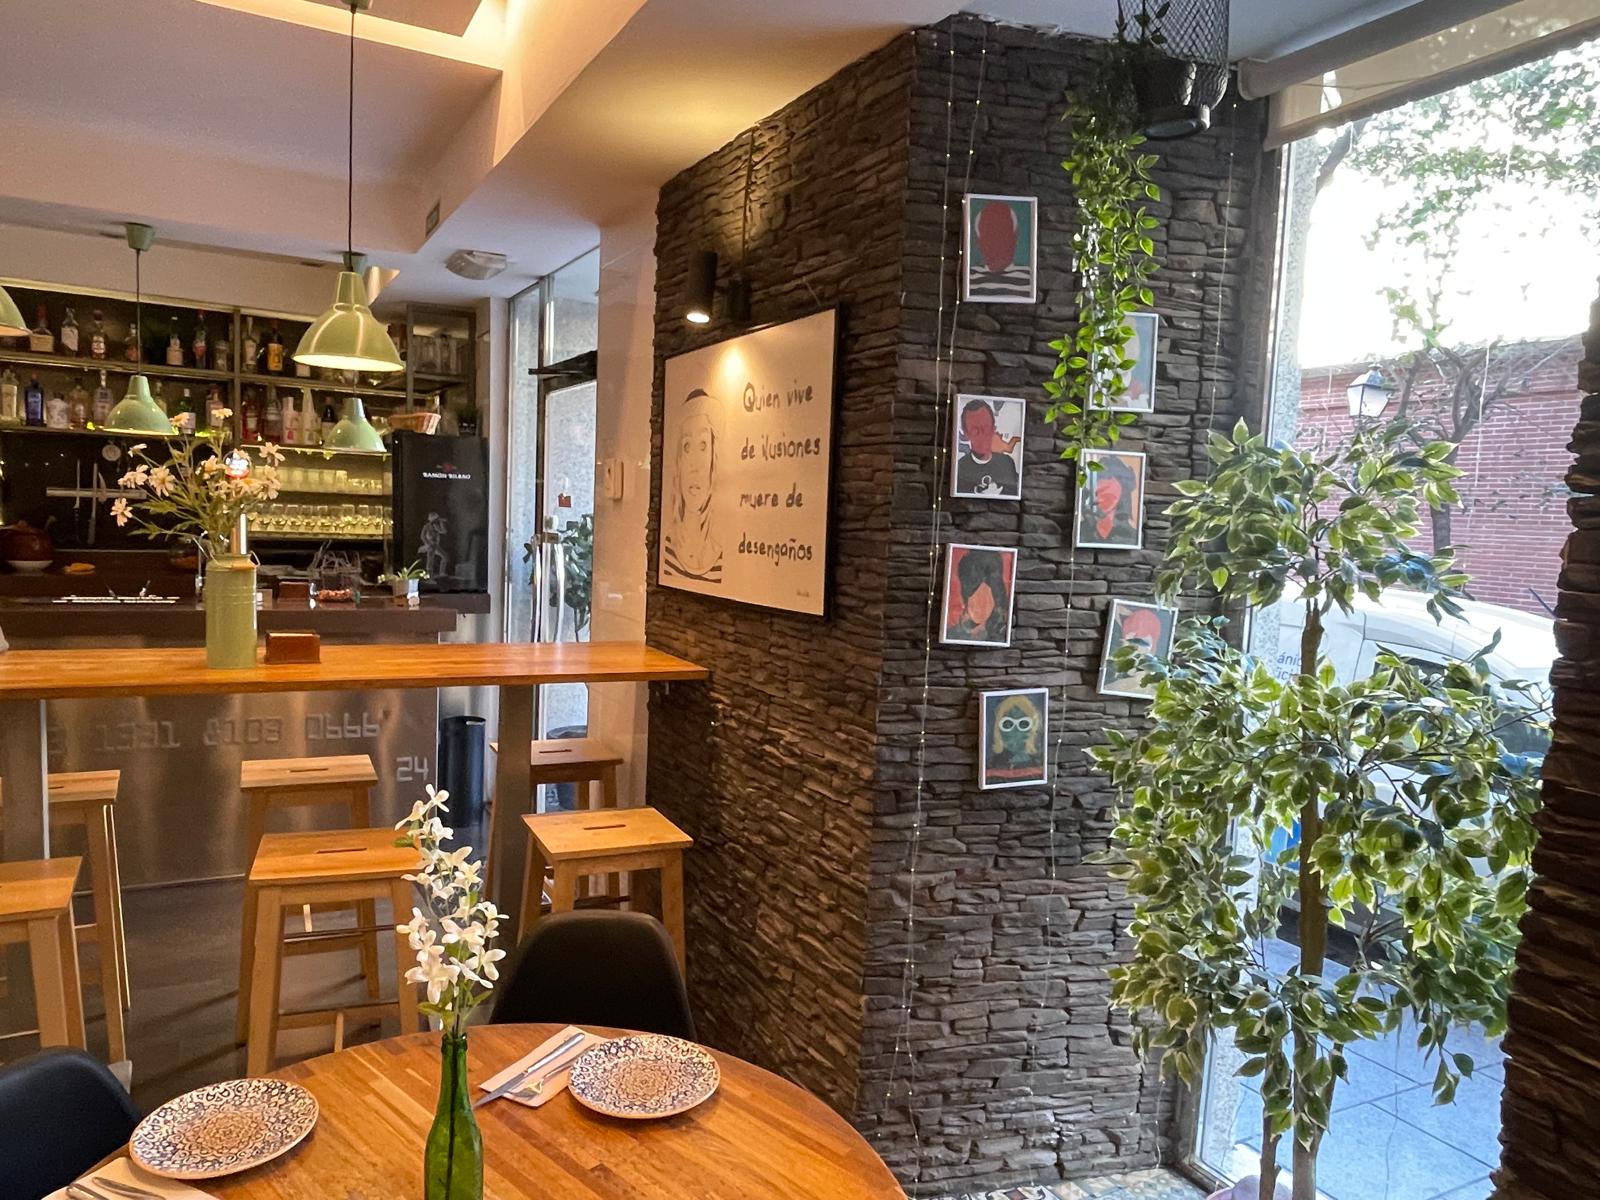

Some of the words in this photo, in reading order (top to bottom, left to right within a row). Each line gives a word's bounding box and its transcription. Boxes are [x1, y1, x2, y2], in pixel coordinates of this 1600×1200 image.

[743, 382, 780, 412] Quien
[787, 379, 813, 407] vive
[741, 437, 756, 461] de
[762, 432, 821, 461] ilusiones
[739, 492, 779, 509] muere
[785, 482, 803, 508] de
[738, 531, 813, 567] desengaños
[396, 755, 430, 782] 24
